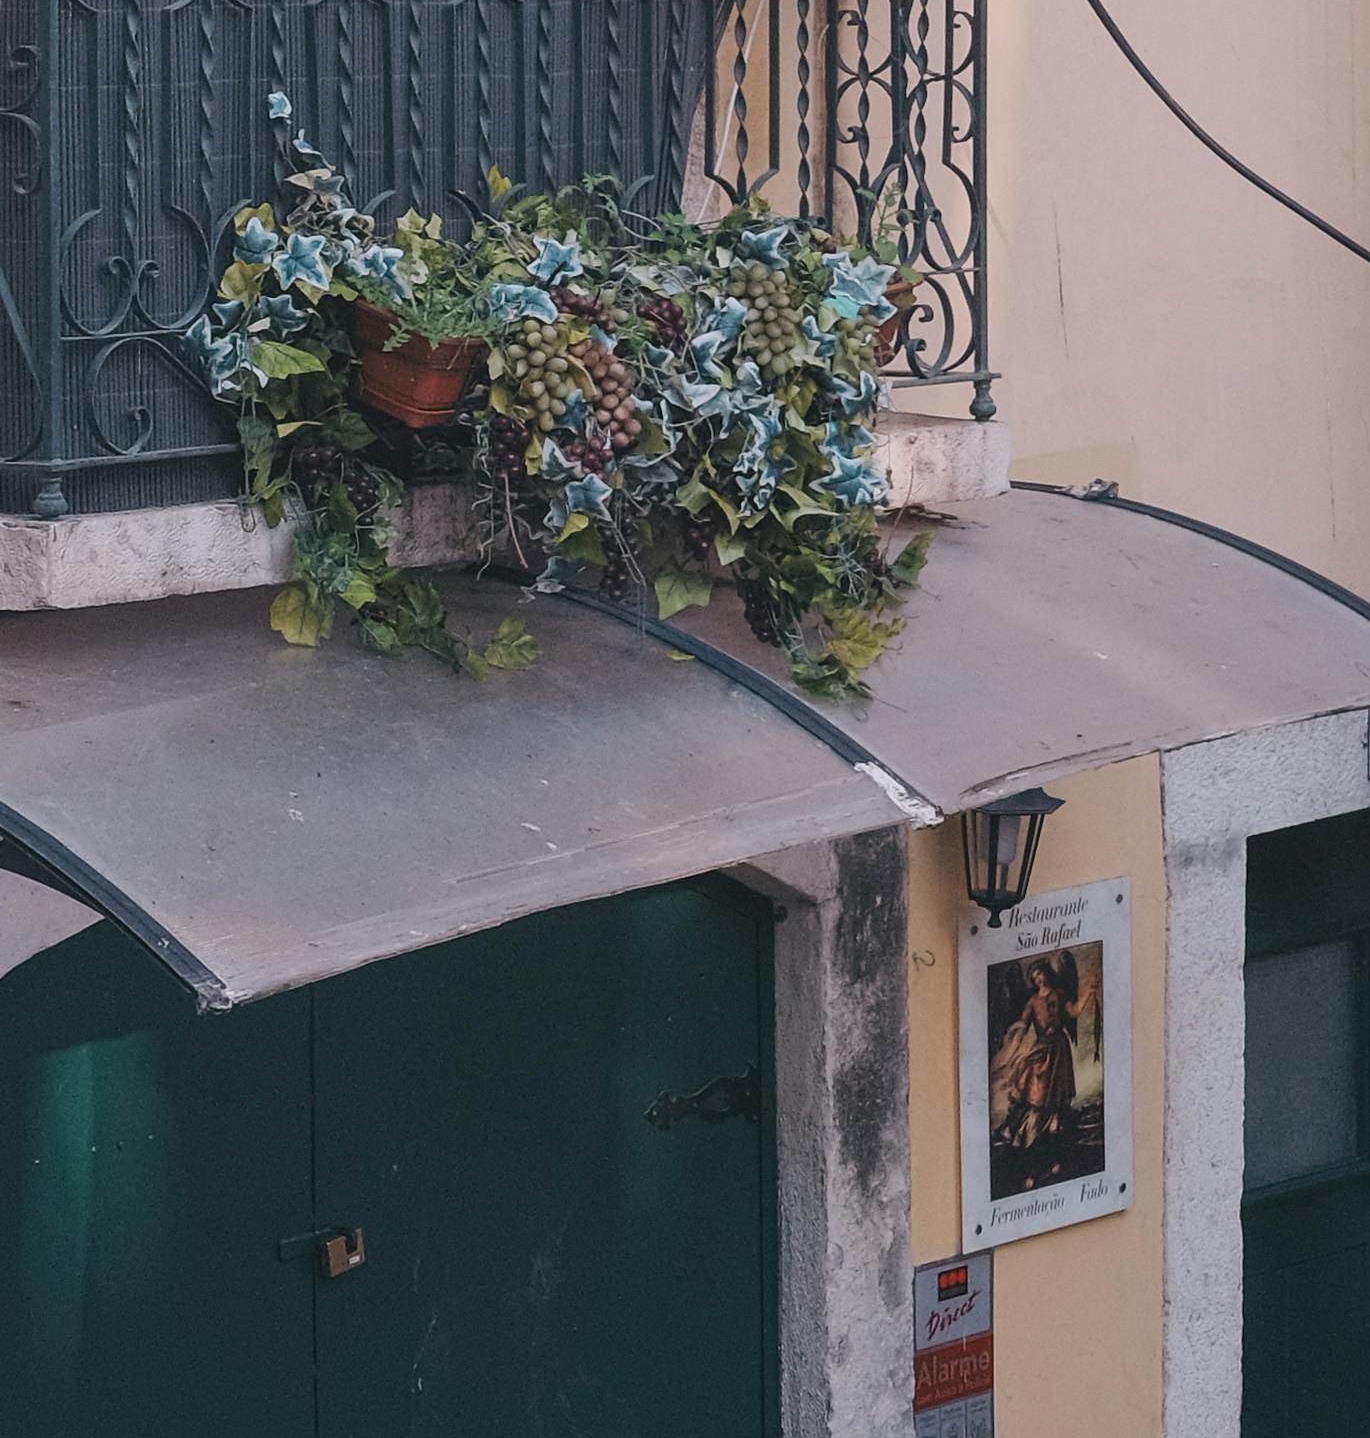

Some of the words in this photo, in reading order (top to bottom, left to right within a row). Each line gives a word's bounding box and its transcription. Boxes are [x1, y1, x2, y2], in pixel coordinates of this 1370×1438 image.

[1007, 897, 1089, 929] Restaurante
[1015, 931, 1039, 951] São
[1039, 919, 1082, 948] Rafael
[916, 1351, 991, 1390] Alarme
